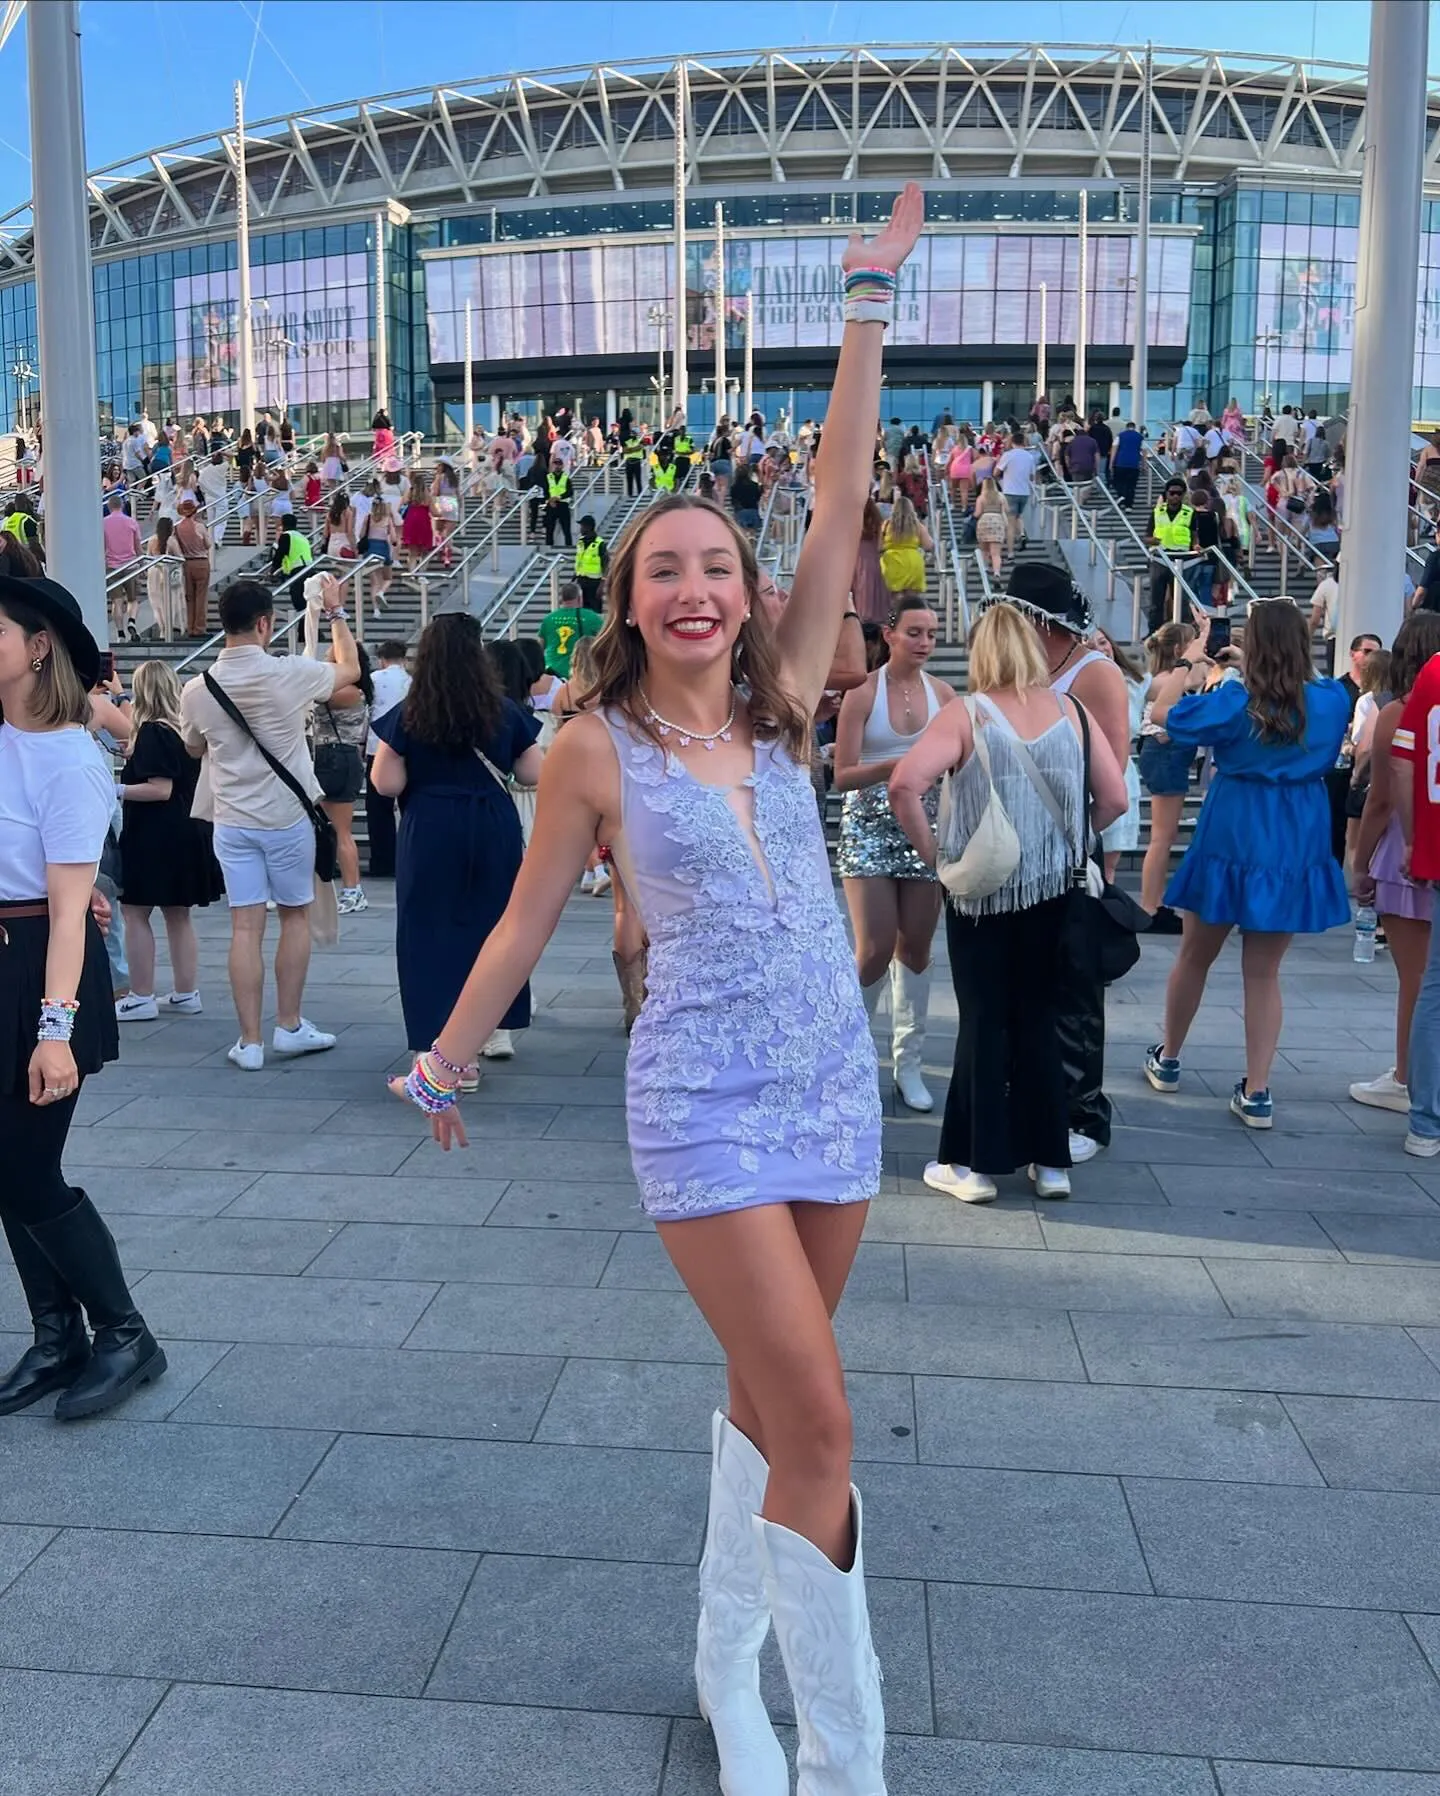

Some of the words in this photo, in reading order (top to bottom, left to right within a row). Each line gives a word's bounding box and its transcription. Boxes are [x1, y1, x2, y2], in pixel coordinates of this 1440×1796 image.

[753, 263, 844, 304] TAYLOR
[303, 304, 356, 342] SWIFT
[753, 304, 798, 325] THE
